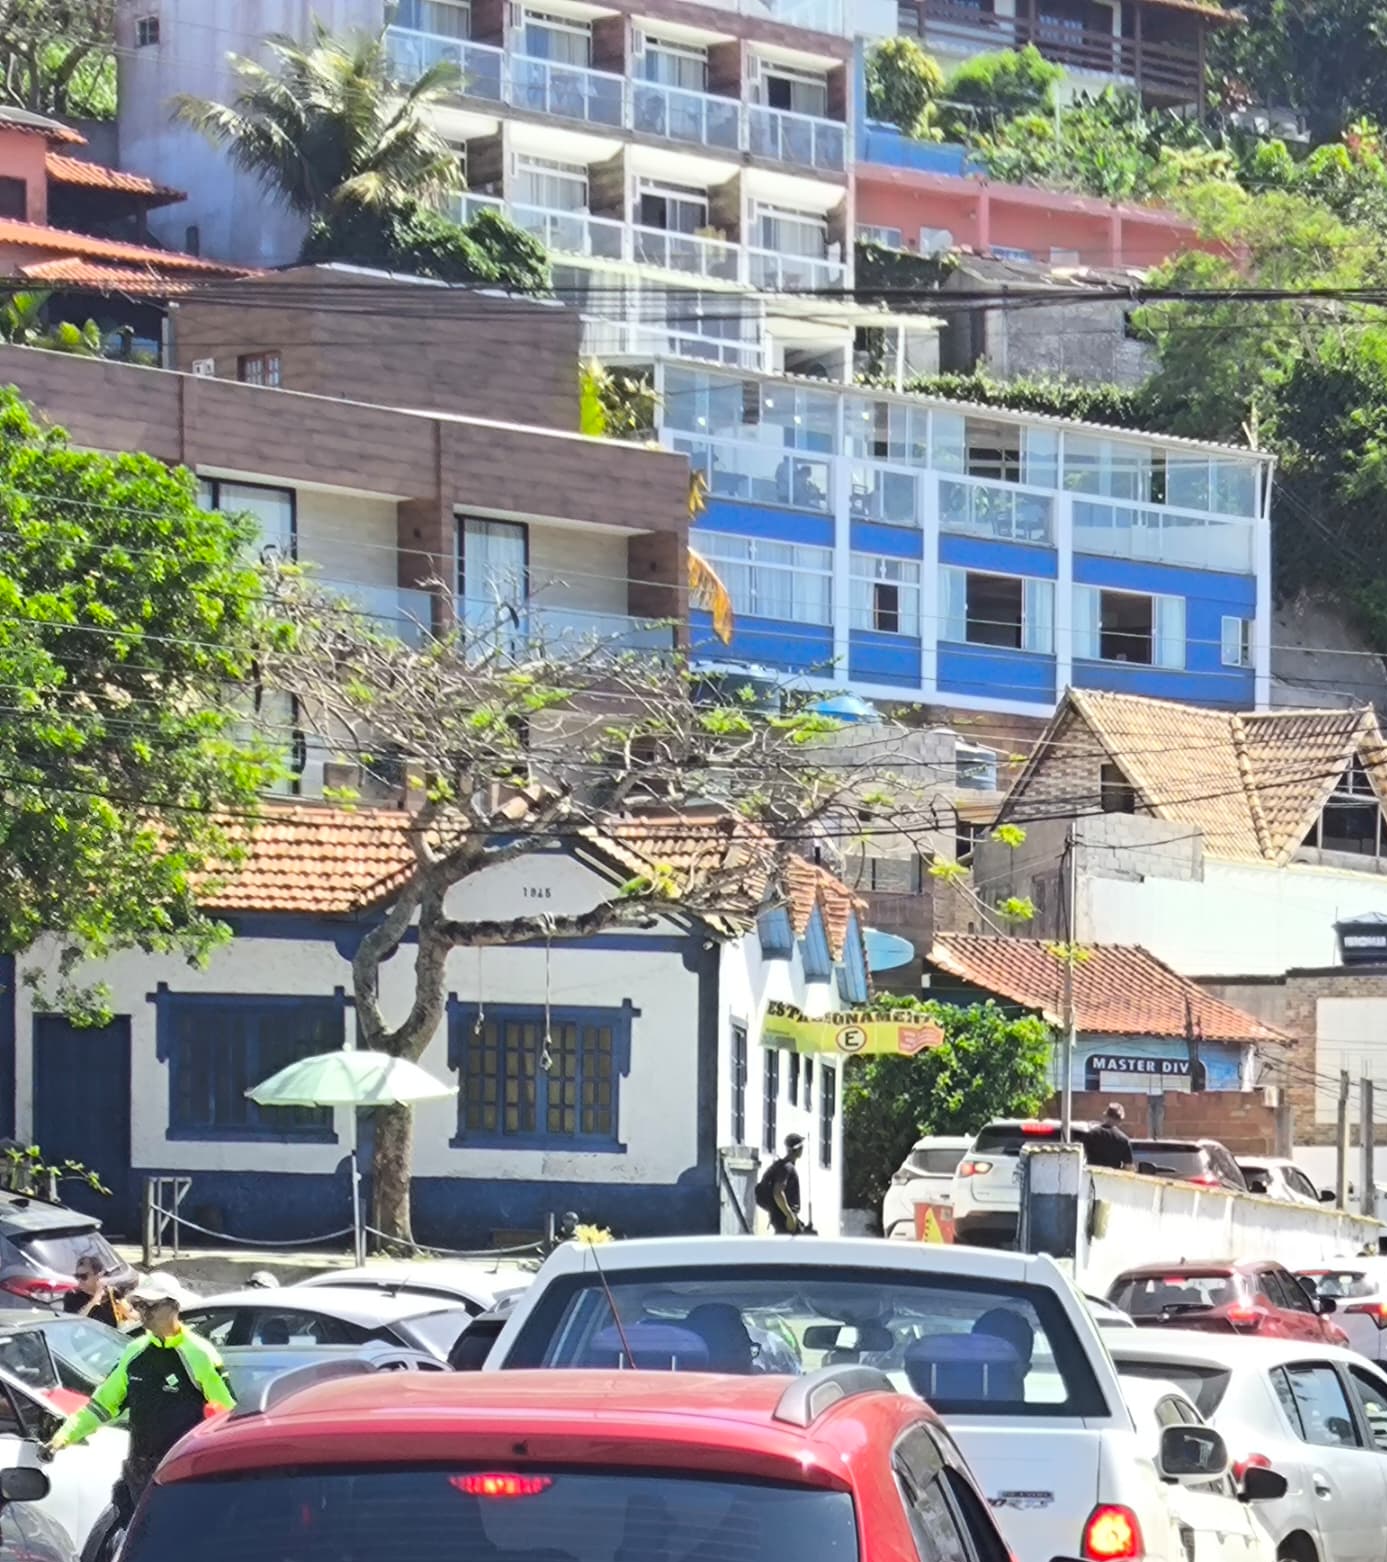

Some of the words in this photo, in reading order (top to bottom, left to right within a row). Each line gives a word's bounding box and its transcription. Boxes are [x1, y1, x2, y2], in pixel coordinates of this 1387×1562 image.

[844, 1030, 859, 1047] E
[1092, 1058, 1156, 1073] MASTER
[1162, 1061, 1190, 1074] DIV
